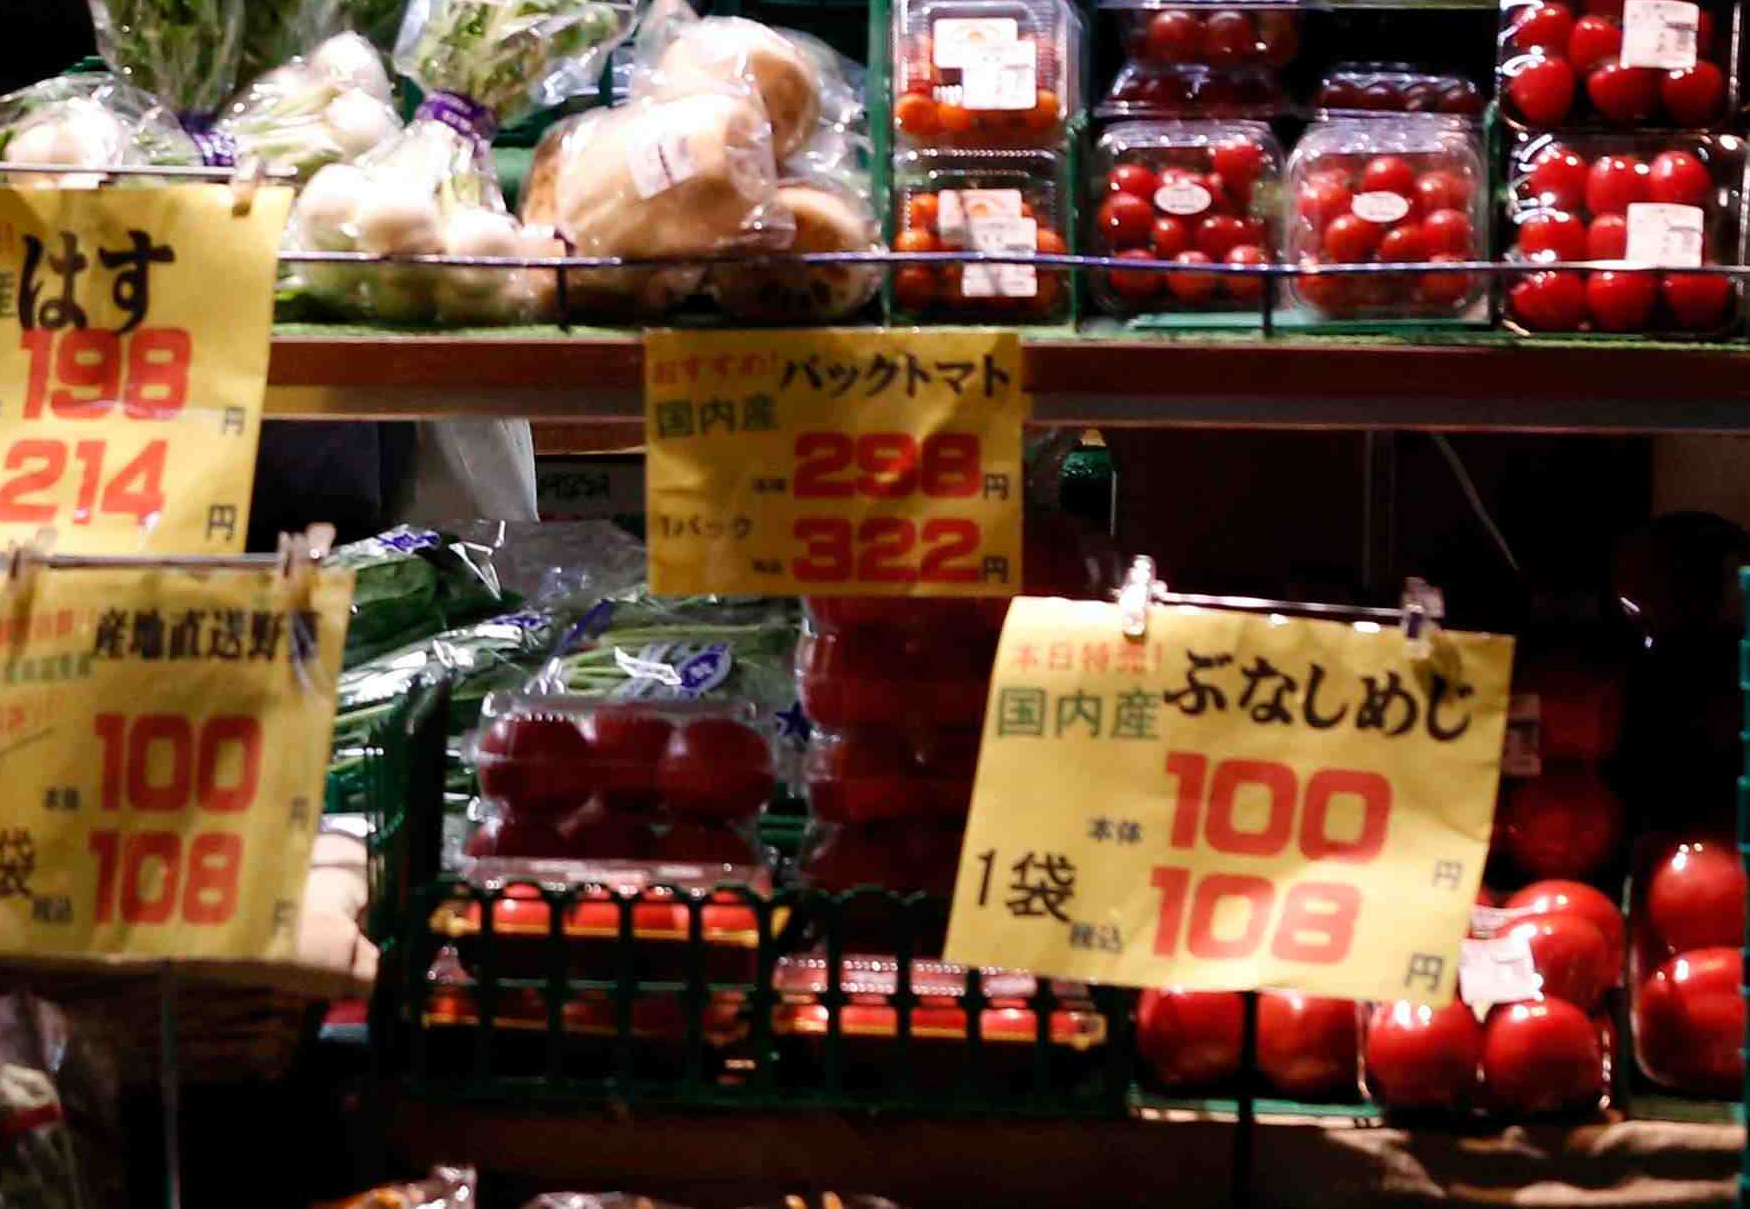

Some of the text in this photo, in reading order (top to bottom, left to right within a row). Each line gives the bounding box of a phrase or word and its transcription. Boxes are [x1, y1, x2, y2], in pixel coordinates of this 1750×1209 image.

[17, 230, 175, 333] はす
[19, 326, 192, 421] 198
[221, 405, 246, 436] 円
[656, 395, 778, 439] 国内産
[792, 431, 982, 500] 298
[983, 473, 1009, 502] 円
[206, 503, 238, 541] 円
[792, 517, 982, 583] 322
[983, 556, 1009, 582] 円
[996, 686, 1164, 742] 国内産
[1163, 648, 1475, 742] ぶなしめじ
[94, 713, 262, 816] 100
[1086, 751, 1464, 891] 本体 100 円
[88, 829, 246, 926] 108
[976, 848, 1076, 923] 1袋
[1067, 864, 1445, 990] 税込 108 円
